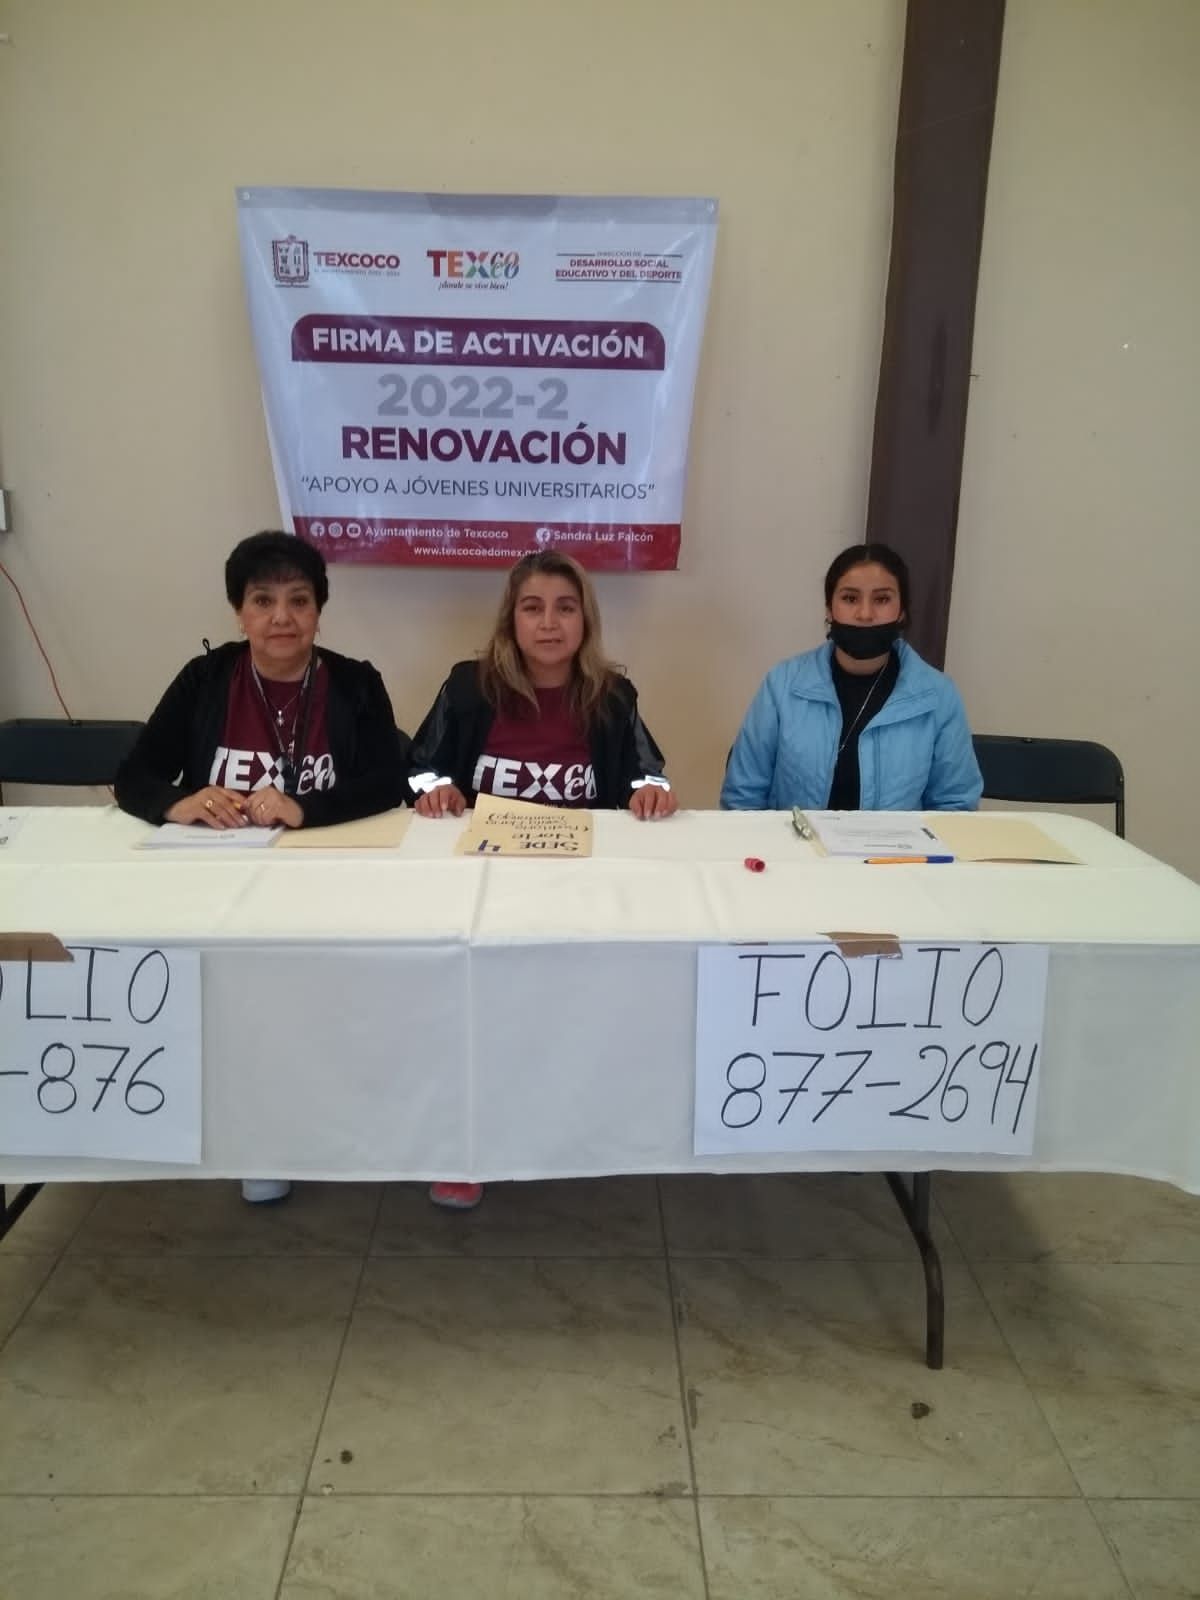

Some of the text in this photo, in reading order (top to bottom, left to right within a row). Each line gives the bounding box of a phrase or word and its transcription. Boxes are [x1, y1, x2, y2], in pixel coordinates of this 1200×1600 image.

[313, 252, 400, 269] TEXCOCO
[569, 259, 669, 268] DESARROLLO SOCIAL
[555, 269, 682, 279] EDUCATIVO Y DEL DEPORTE
[312, 327, 645, 359] FIRMA DE ACTIVACIÓN
[377, 373, 569, 420] 2022-2
[341, 421, 627, 465] RENOVACIÓN
[384, 478, 398, 493] A
[402, 475, 489, 497] JÓVENES
[365, 525, 509, 539] Ayuntamiento de Texcoco
[554, 530, 654, 543] Sandra Luz Falcón
[478, 839, 579, 852] SEDE 4
[0, 945, 170, 1024] LIO
[738, 946, 1004, 1031] FOLIO
[720, 1040, 1039, 1134] 877-2694
